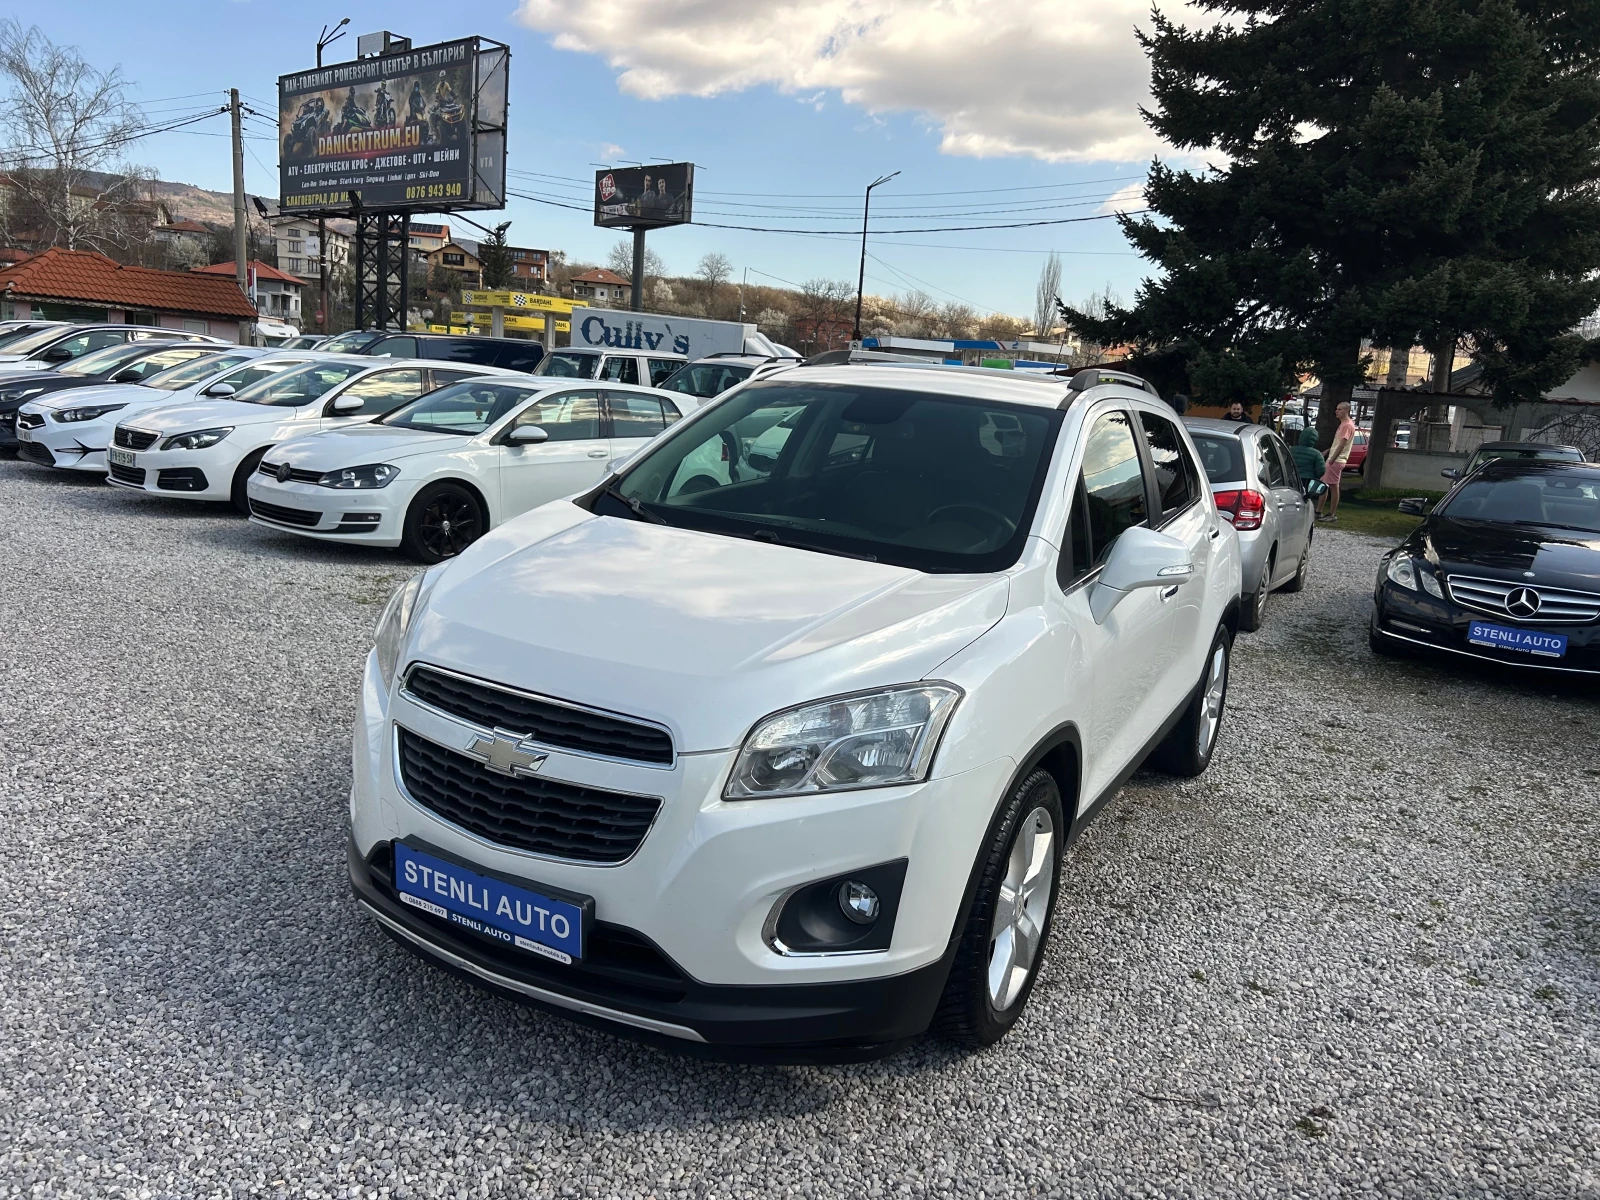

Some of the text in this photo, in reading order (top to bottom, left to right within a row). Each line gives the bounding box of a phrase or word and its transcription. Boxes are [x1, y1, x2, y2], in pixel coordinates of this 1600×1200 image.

[334, 62, 380, 82] POWERSPORT
[382, 56, 411, 76] ЦЕНТЪР
[414, 54, 419, 68] В
[422, 45, 464, 67] БЪЛГАРИЯ
[318, 125, 420, 156] DANICENTRUM.EU
[288, 148, 460, 177] ATV ЕЛЕКТРИЧЕСКИ КРОС ДЖЕТОВЕ UTV ШЕЙНИ
[286, 192, 327, 207] БЛАГОЕВГРАД
[329, 192, 338, 205] ДО
[406, 182, 461, 199] 0876 943 940
[530, 298, 553, 306] BARDAHL
[1473, 626, 1562, 649] STENLI AUTO
[404, 860, 570, 938] STENLI AUTO
[452, 912, 481, 931] STENLI
[484, 926, 511, 941] AUTO
